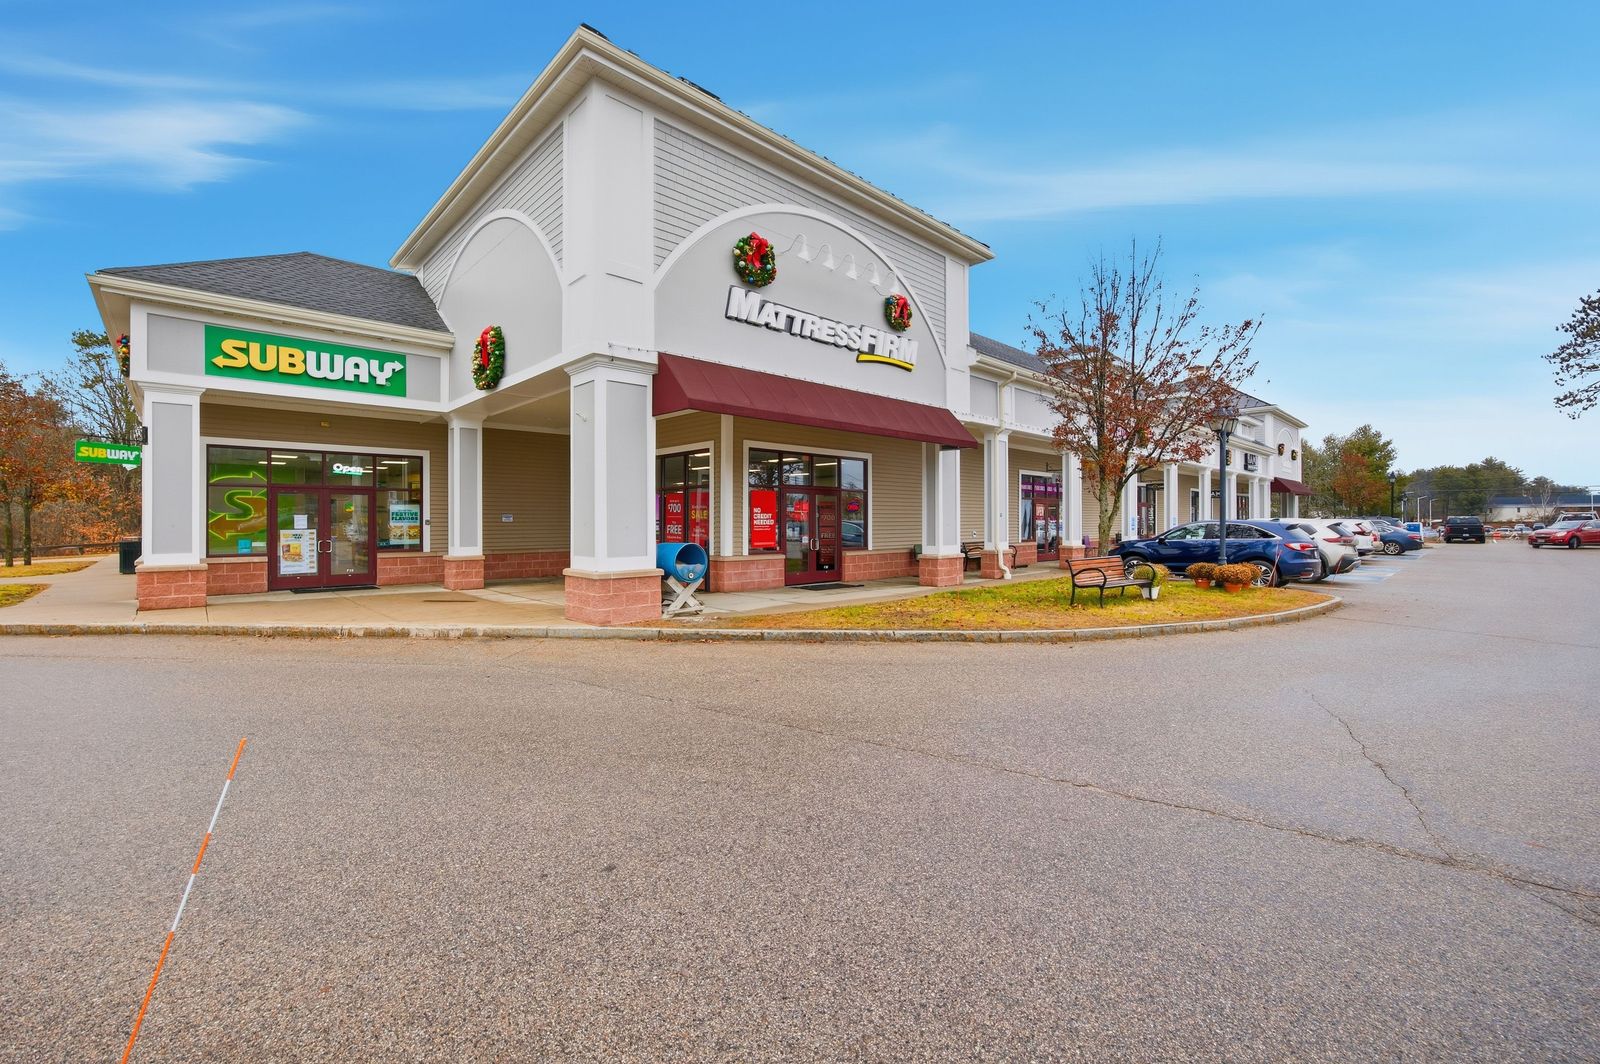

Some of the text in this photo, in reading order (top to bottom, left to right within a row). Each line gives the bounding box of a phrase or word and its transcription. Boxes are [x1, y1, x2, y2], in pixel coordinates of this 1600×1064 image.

[211, 338, 404, 386] SUBWAY
[77, 446, 139, 461] SUBWAY
[333, 463, 363, 475] Open
[691, 510, 708, 519] SALE
[666, 524, 682, 535] FREE
